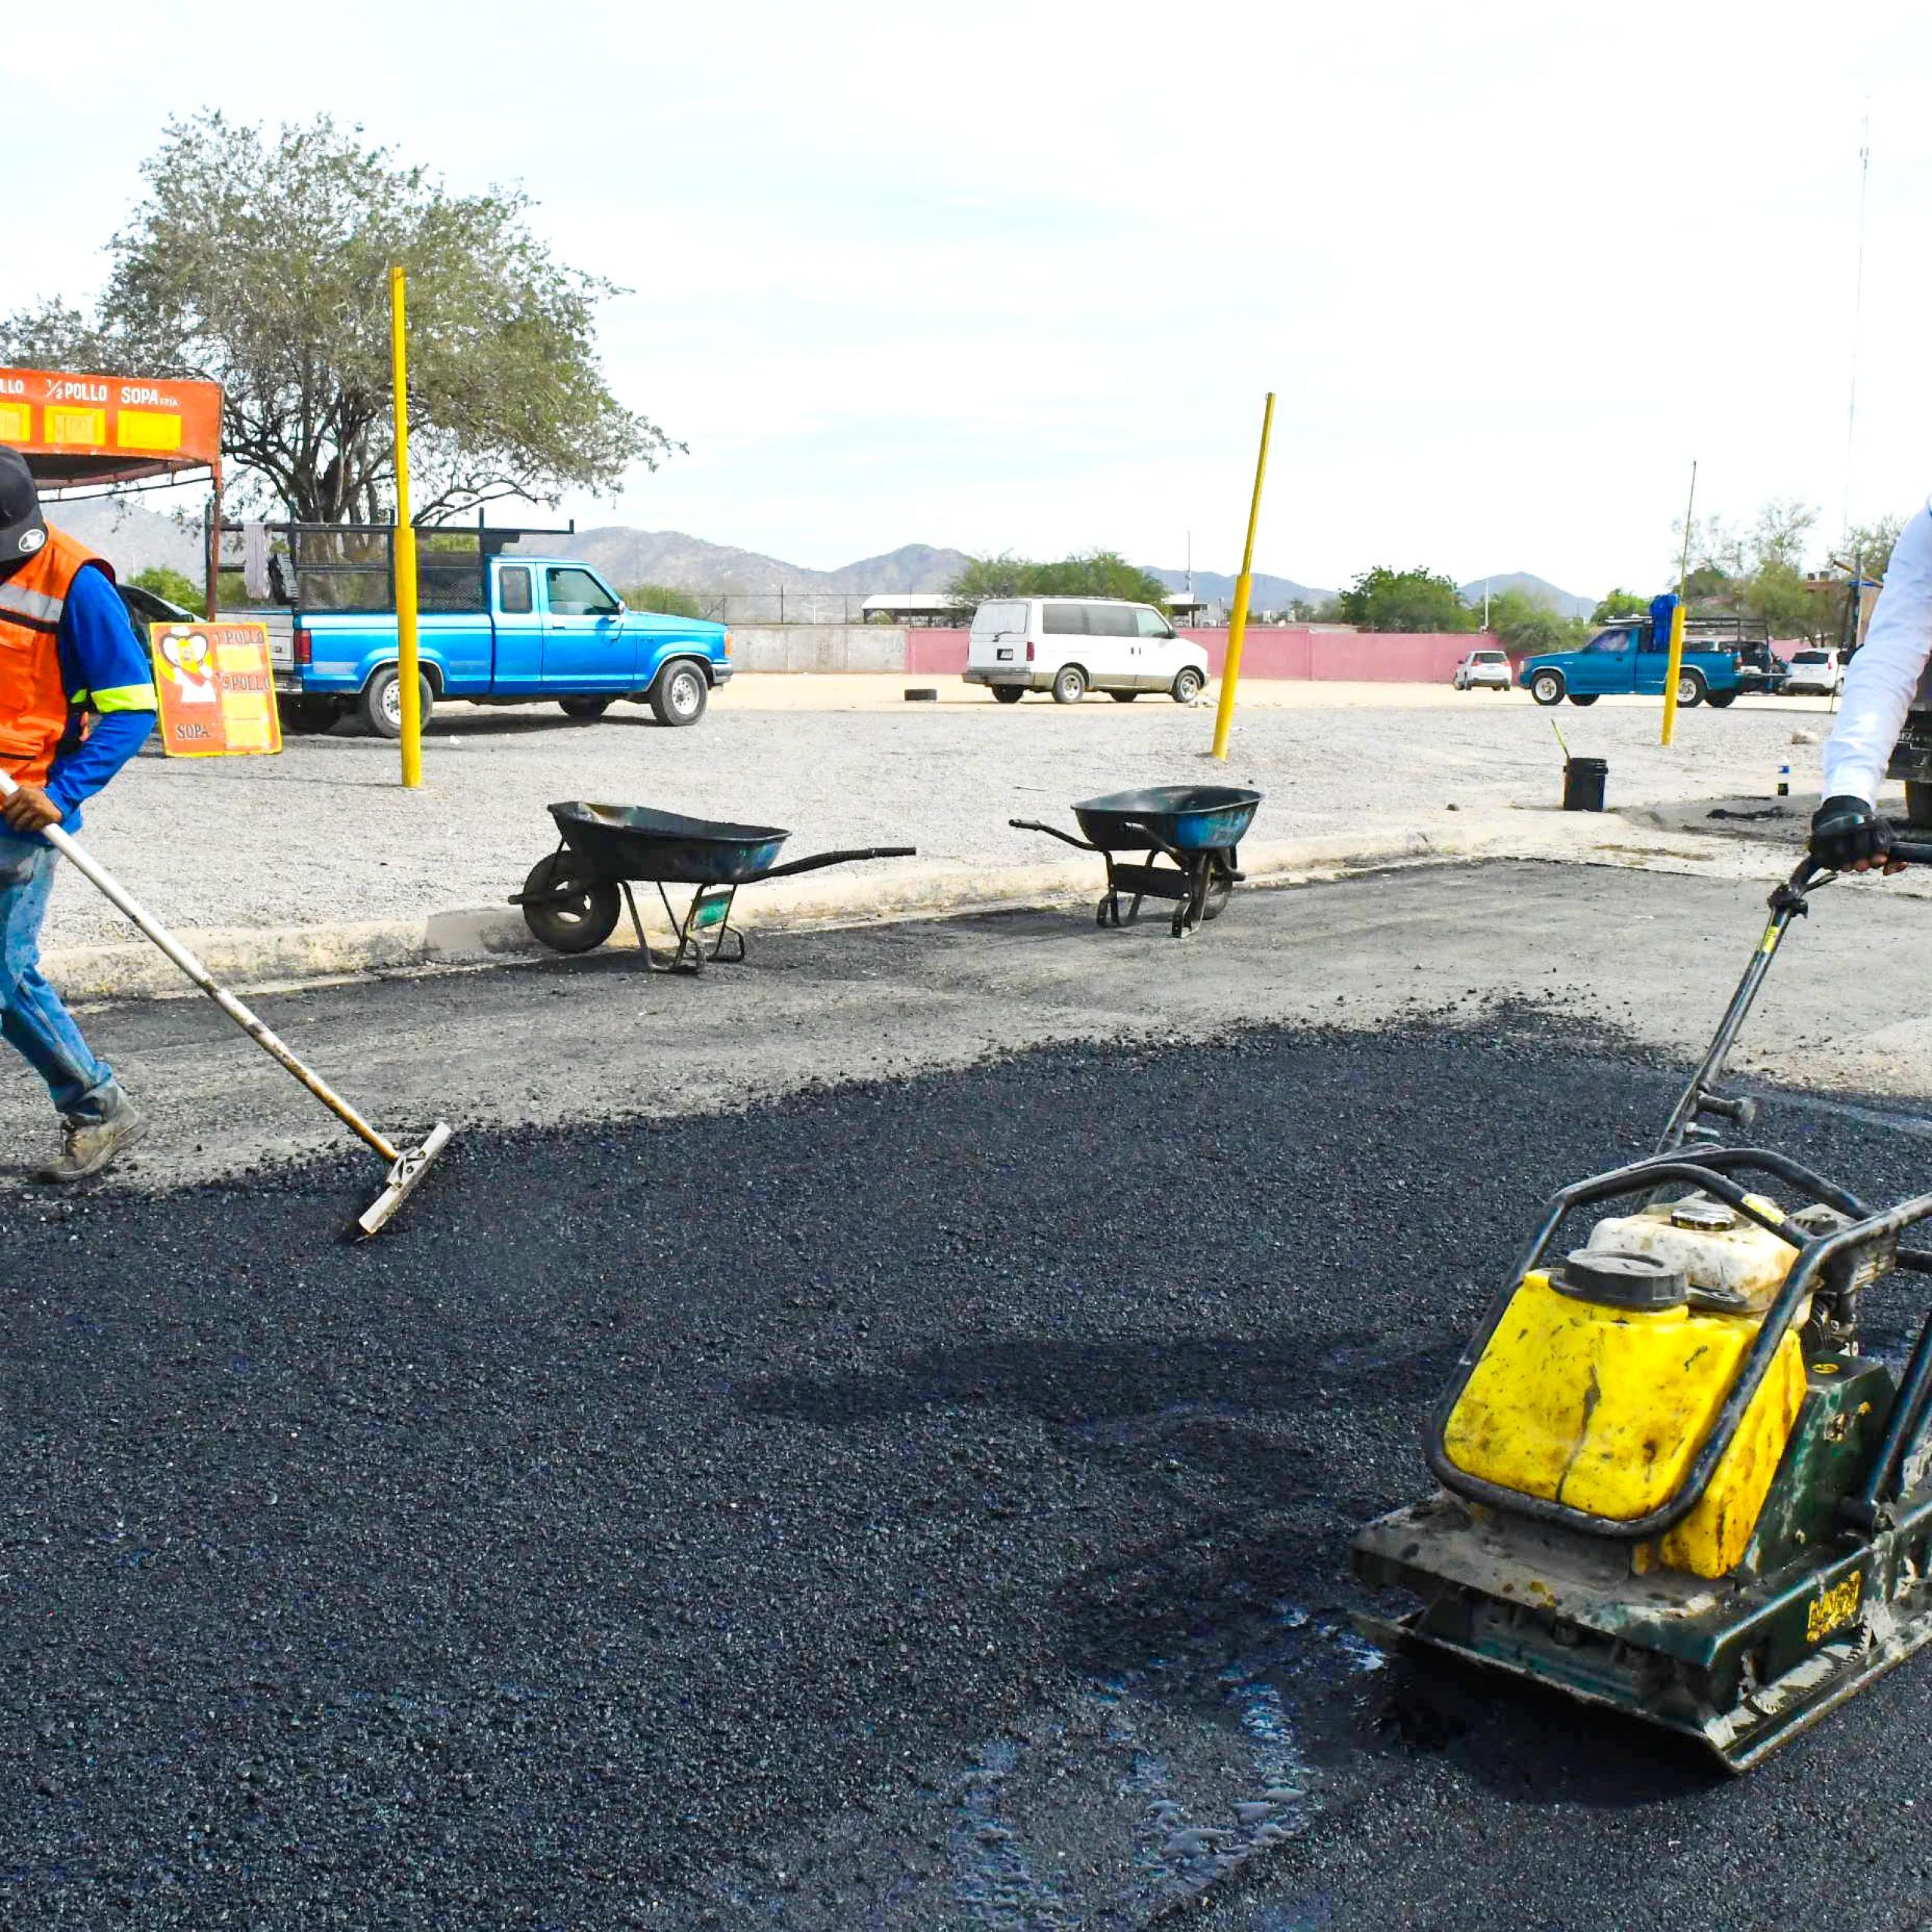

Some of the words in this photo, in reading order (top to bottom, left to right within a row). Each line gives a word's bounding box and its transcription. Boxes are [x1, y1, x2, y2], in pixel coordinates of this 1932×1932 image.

[65, 382, 107, 401] POLLO
[121, 386, 158, 405] SOPA
[224, 630, 264, 645] POLLO
[230, 675, 270, 691] POLLO
[176, 724, 211, 740] SOPA
